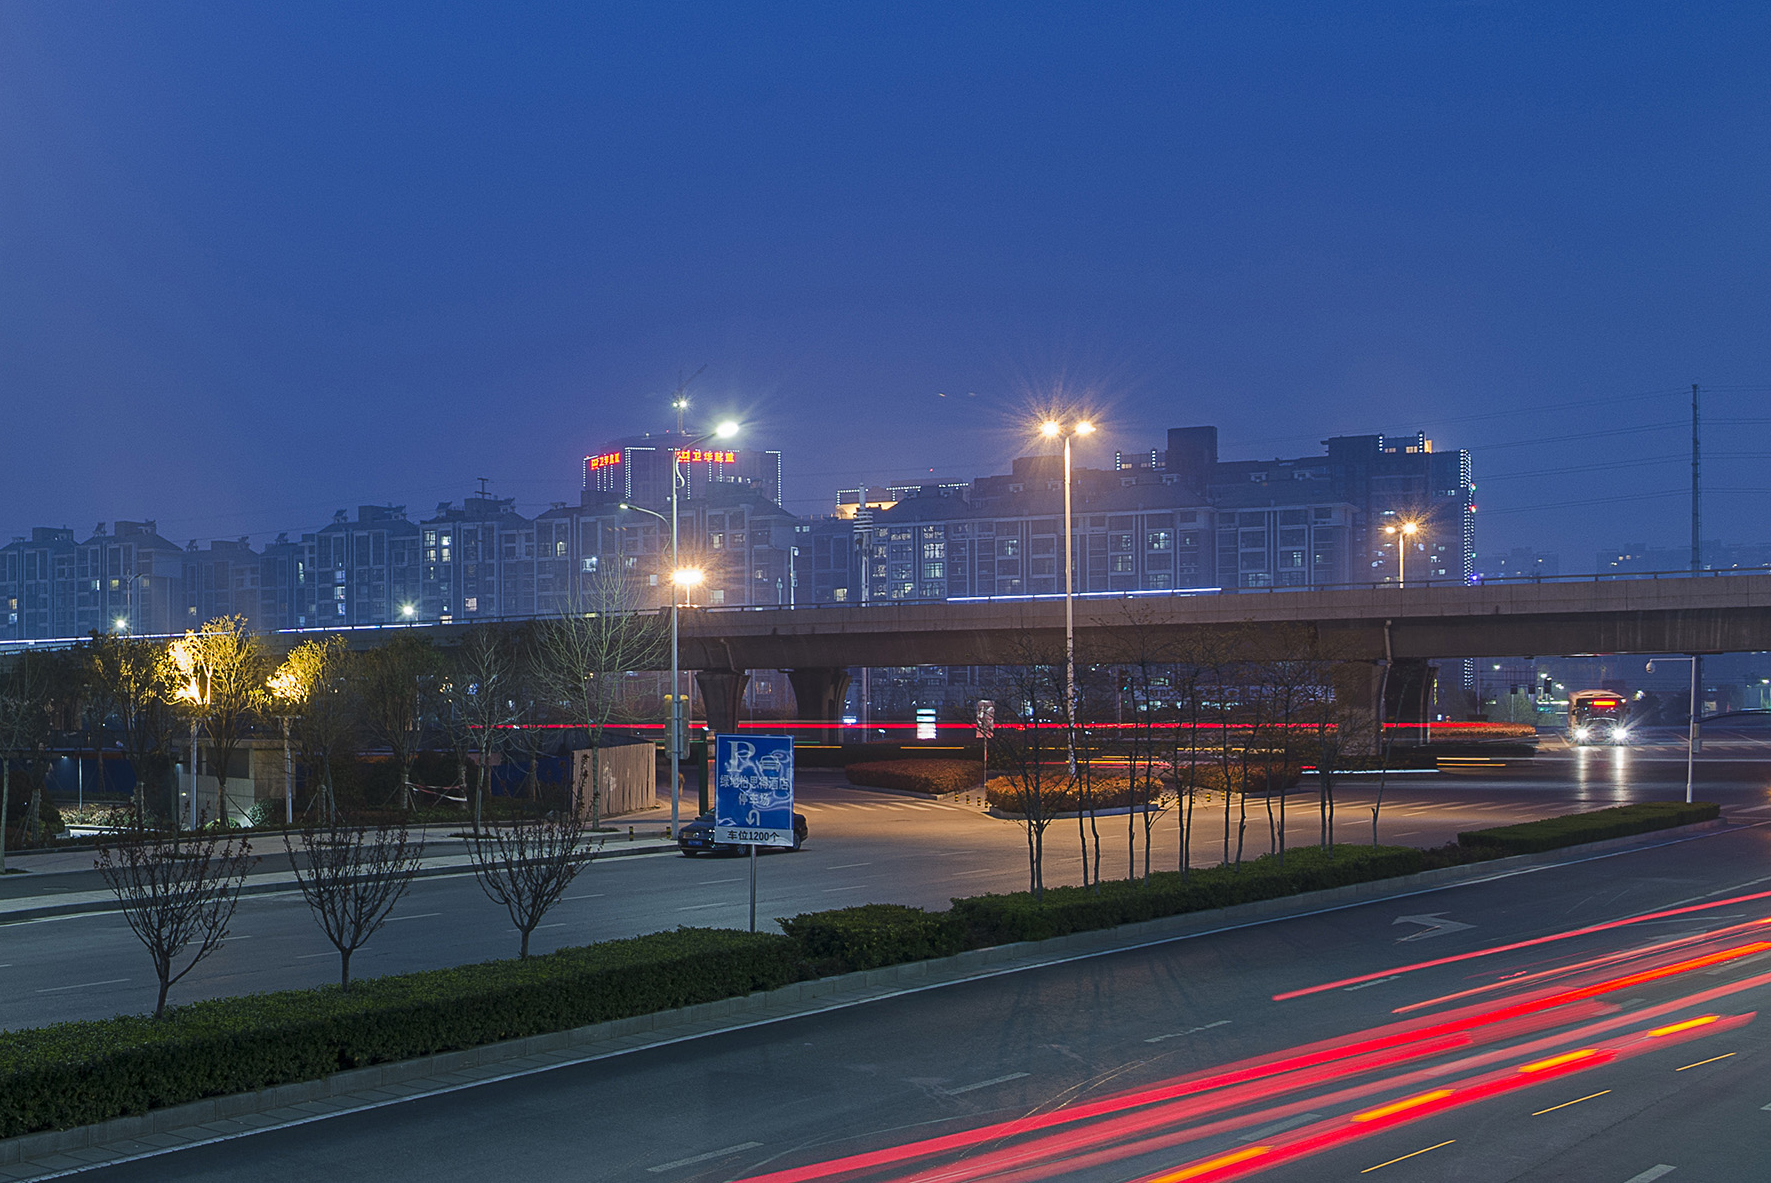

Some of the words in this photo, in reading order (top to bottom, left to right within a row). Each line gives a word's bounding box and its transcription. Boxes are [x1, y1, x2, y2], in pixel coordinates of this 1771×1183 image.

[739, 793, 770, 806] 停车场
[728, 830, 780, 842] 车位1200个
